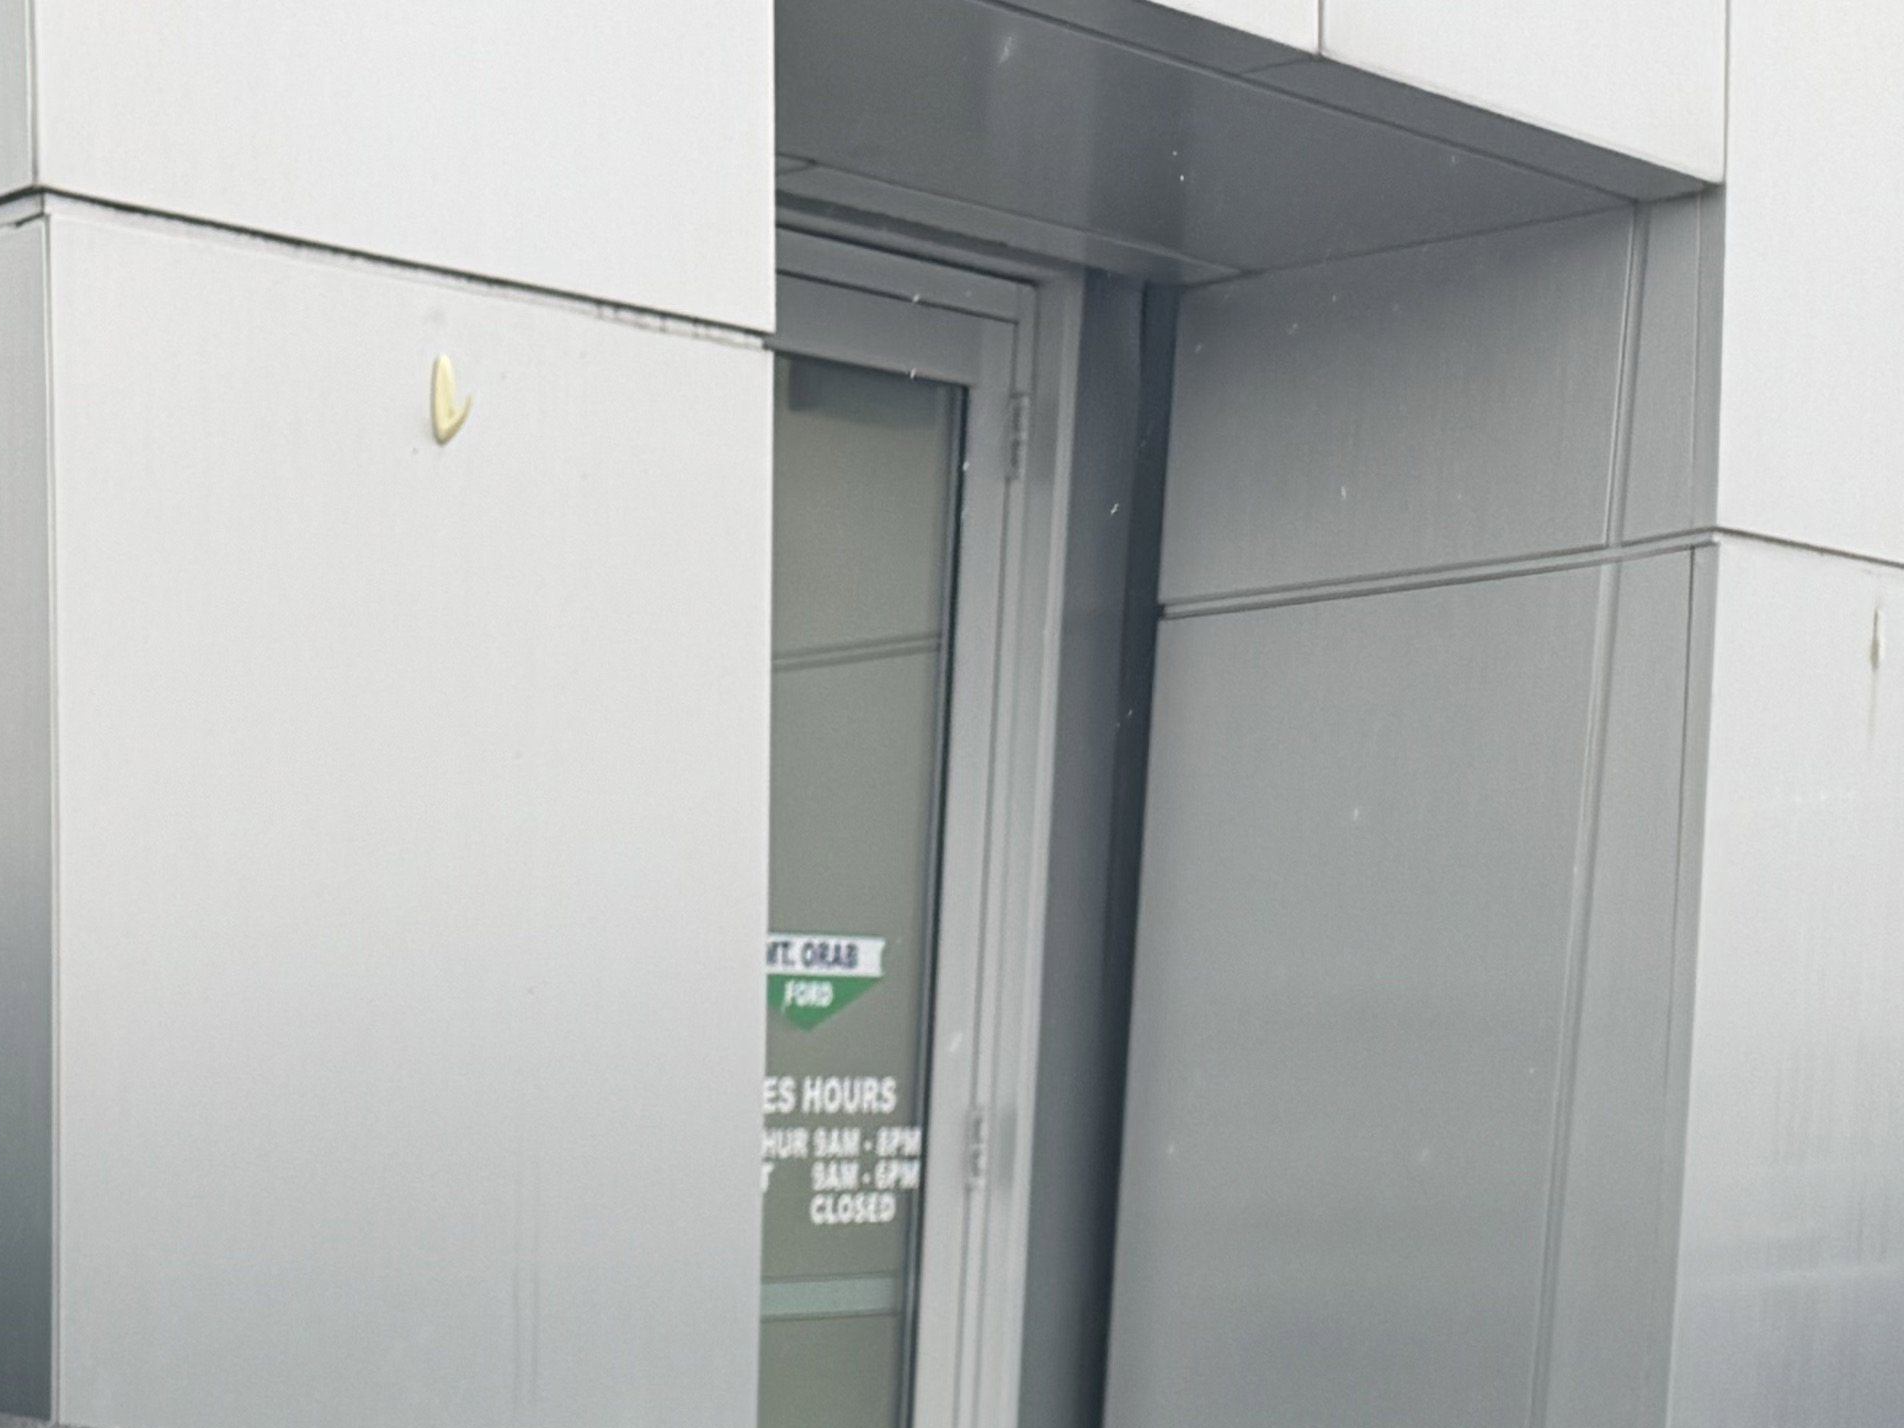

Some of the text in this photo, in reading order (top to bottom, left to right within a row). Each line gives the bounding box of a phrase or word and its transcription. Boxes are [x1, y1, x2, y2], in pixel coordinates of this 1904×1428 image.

[800, 941, 859, 969] ORAB
[782, 978, 834, 1009] FORD
[801, 1075, 897, 1115] HOURS
[809, 1192, 897, 1226] CLOSED
